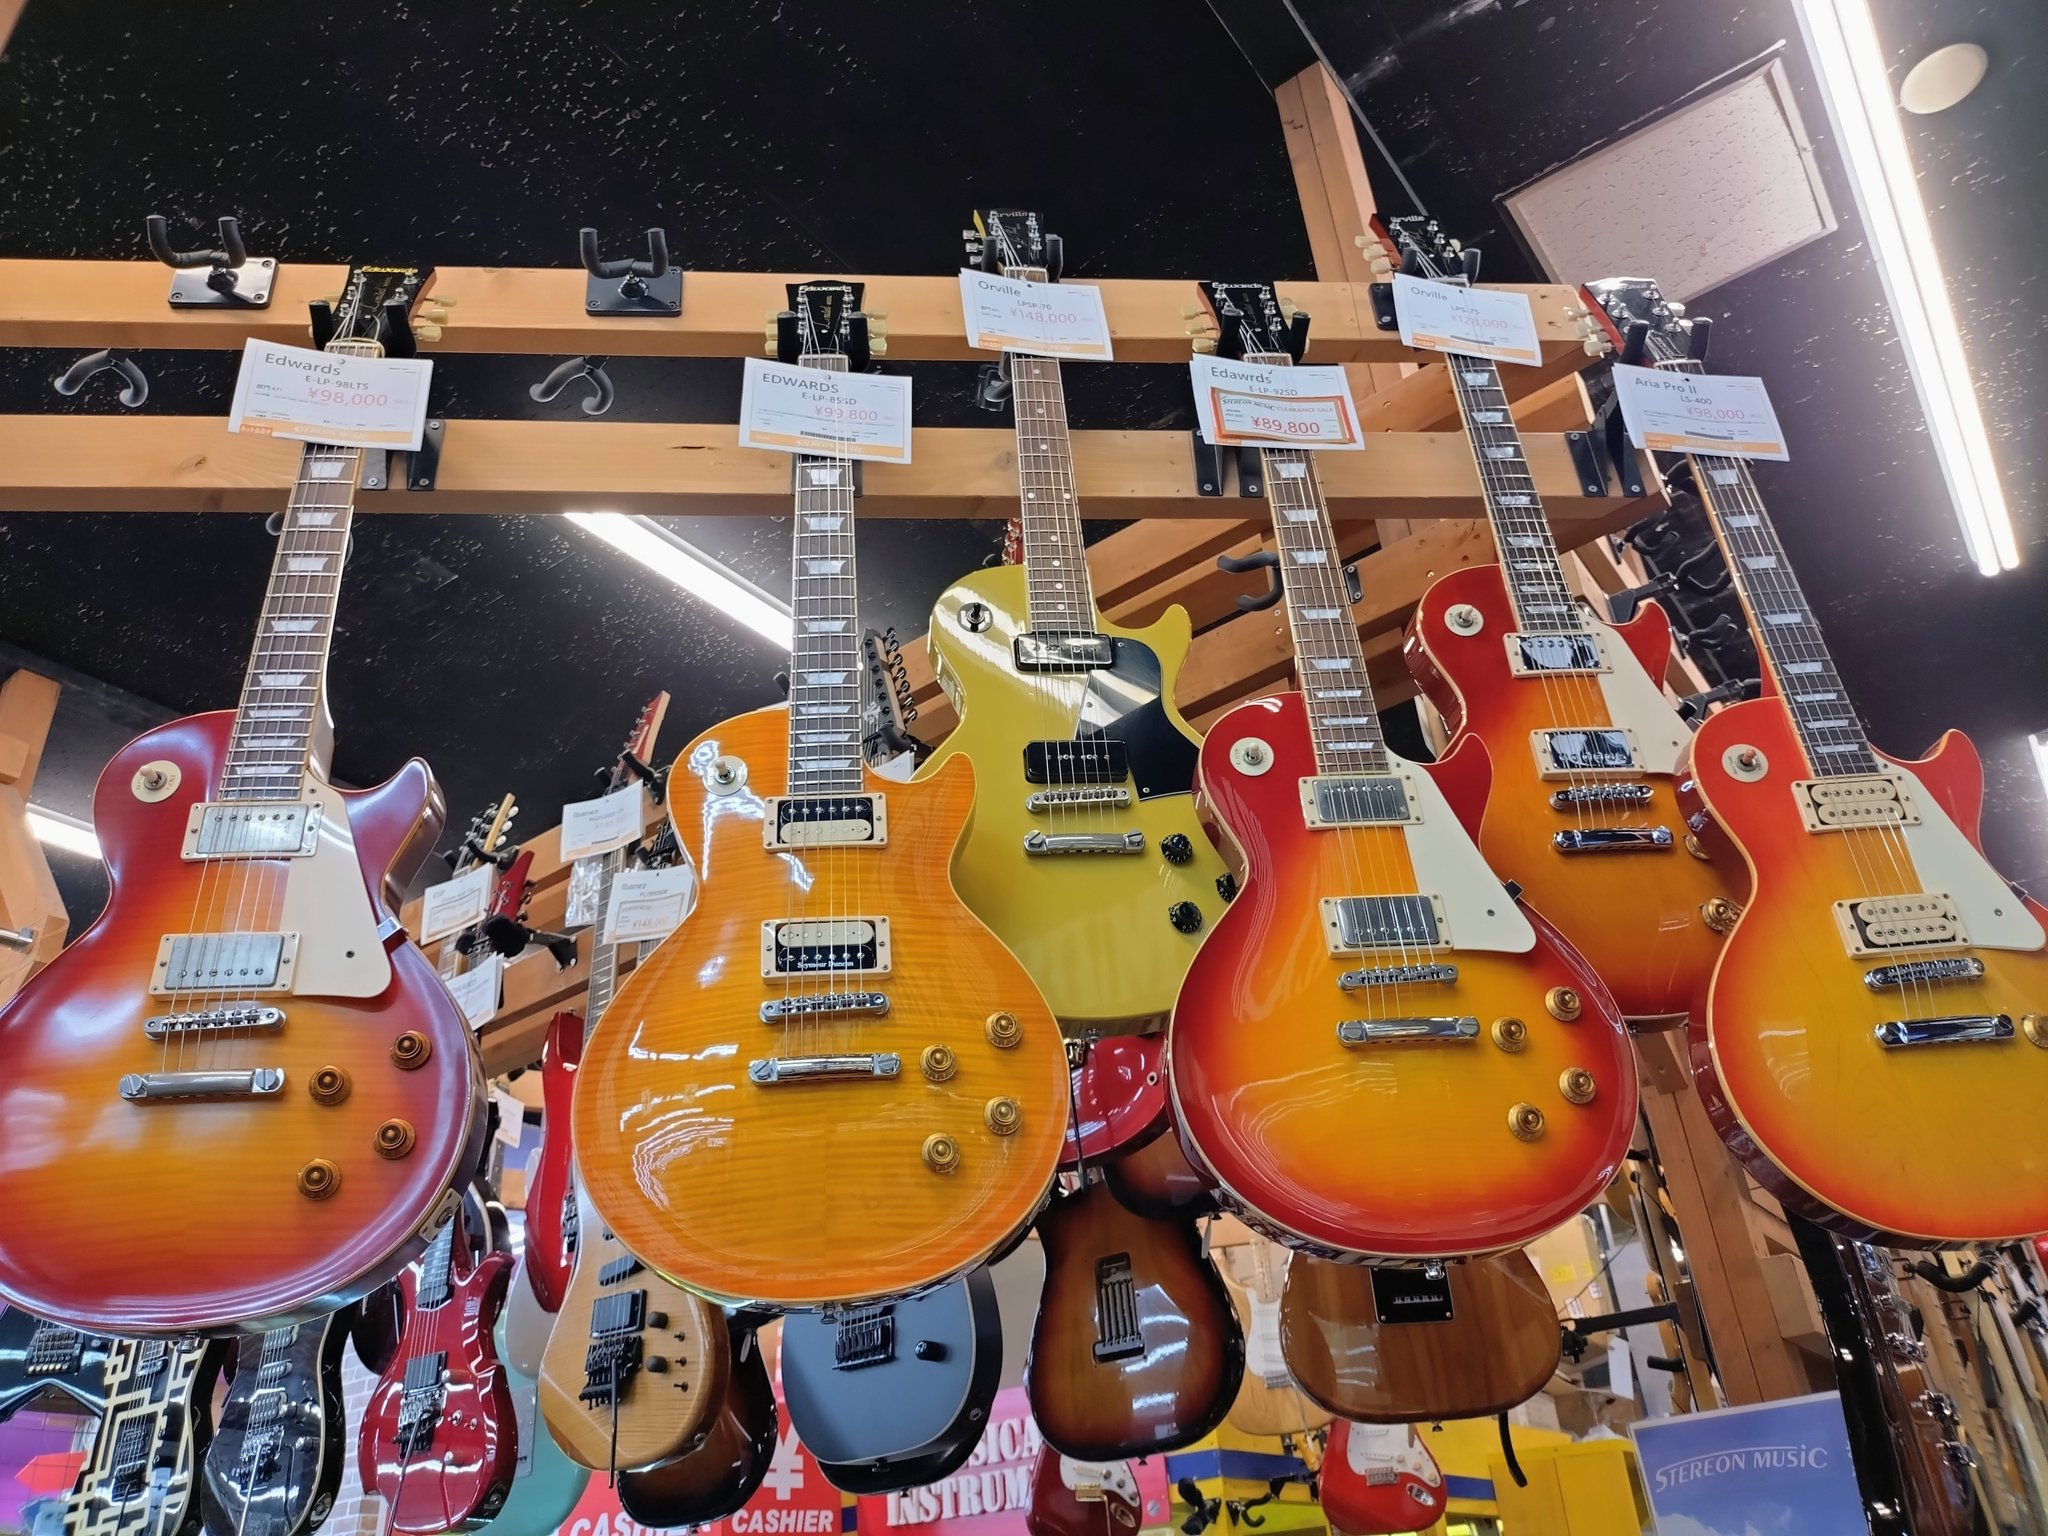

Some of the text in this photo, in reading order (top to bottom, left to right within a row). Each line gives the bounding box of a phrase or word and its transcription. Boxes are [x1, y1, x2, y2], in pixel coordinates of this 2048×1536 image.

[978, 280, 1021, 297] Orville
[1410, 286, 1448, 301] Orville
[1010, 308, 1077, 325] ¥148,000
[265, 353, 341, 376] Edwards
[305, 374, 369, 391] E-LP-98LTS
[763, 373, 839, 393] EDWARDS
[1211, 366, 1272, 384] Edawrds
[1249, 385, 1297, 396] E-LP-92SD
[1634, 376, 1660, 389] Aria
[1664, 381, 1685, 394] Pro
[307, 386, 388, 407] ¥98,000
[1684, 405, 1745, 420] ¥98,000
[1251, 415, 1320, 434] ¥89,800
[797, 960, 854, 969] Seymour Duncan
[1655, 1450, 1746, 1493] STEREON
[731, 1509, 834, 1533] CASHIER
